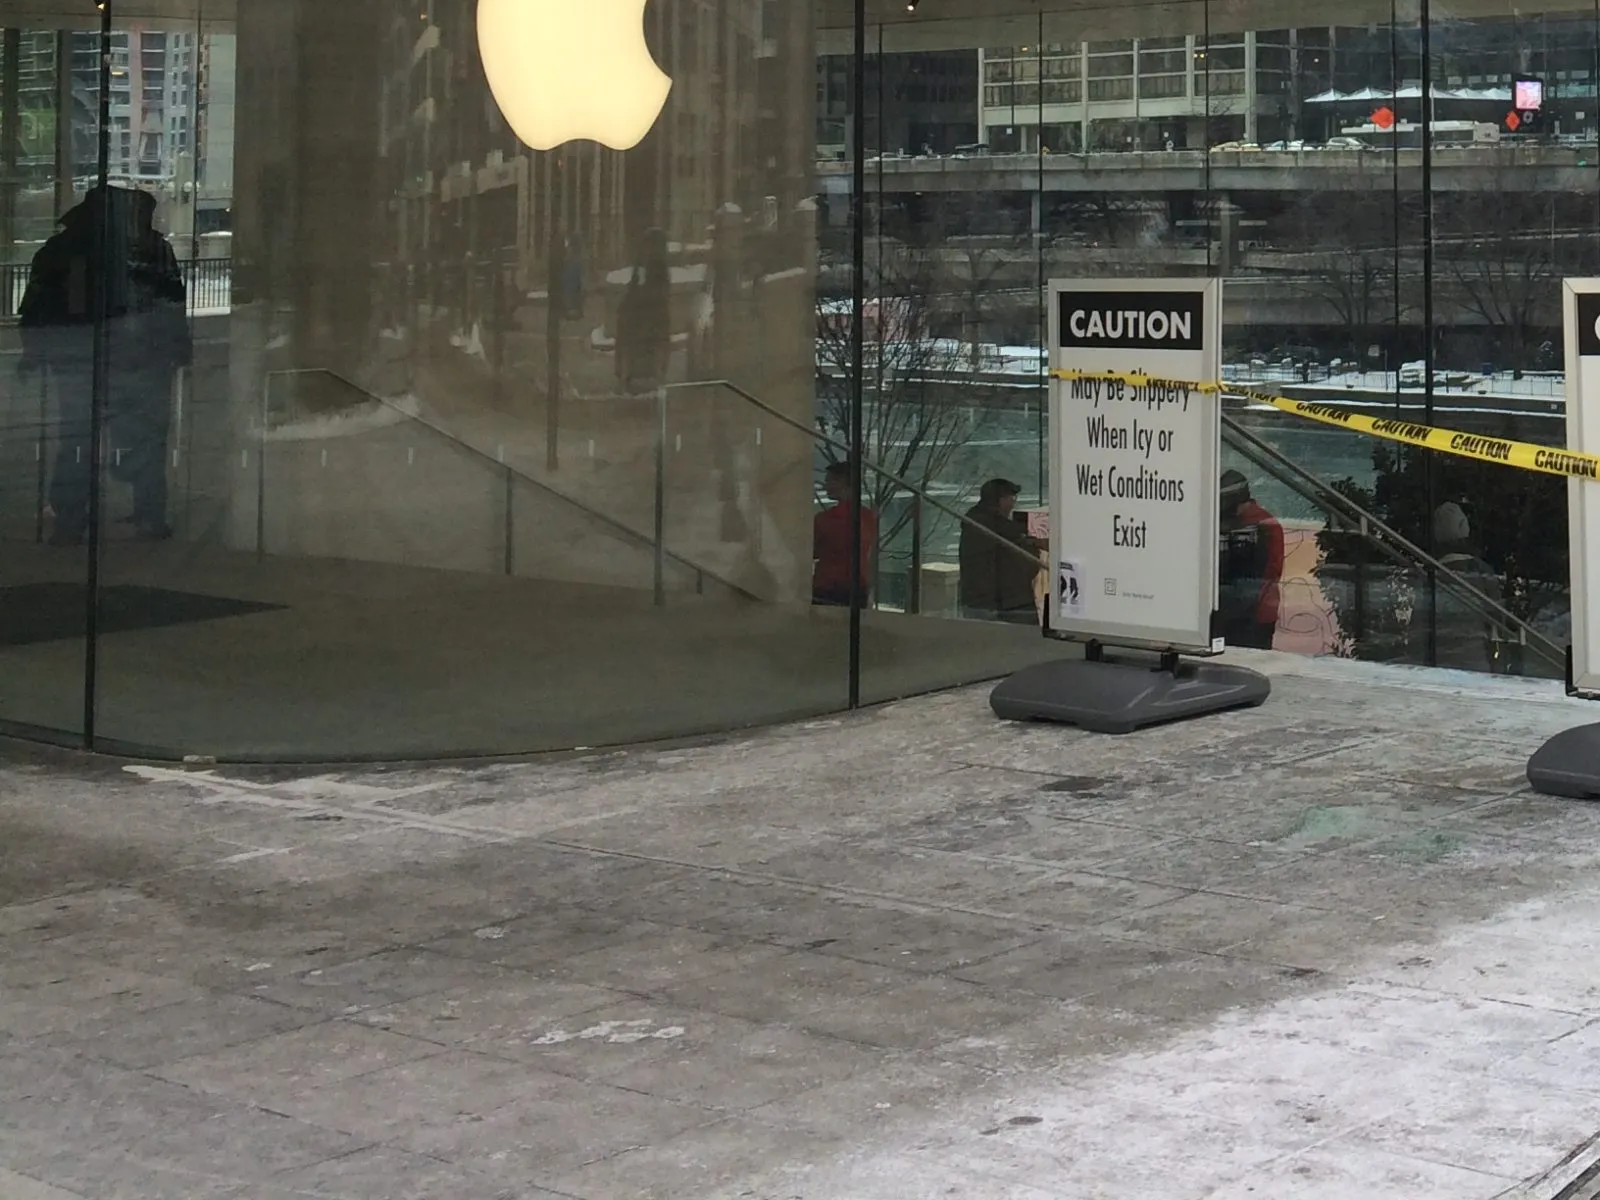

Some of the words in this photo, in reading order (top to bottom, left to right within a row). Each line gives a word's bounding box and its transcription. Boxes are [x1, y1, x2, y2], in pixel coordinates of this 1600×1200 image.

[1070, 309, 1192, 340] CAUTION
[1087, 414, 1127, 449] When
[1133, 418, 1153, 459] Icy
[1158, 429, 1174, 452] or
[1371, 418, 1433, 442] CAUTION
[1449, 433, 1513, 460] CAUTION
[1533, 449, 1598, 478] CAUTION
[1076, 464, 1103, 497] Wet
[1108, 465, 1185, 503] Conditions
[1113, 514, 1147, 549] Exist
